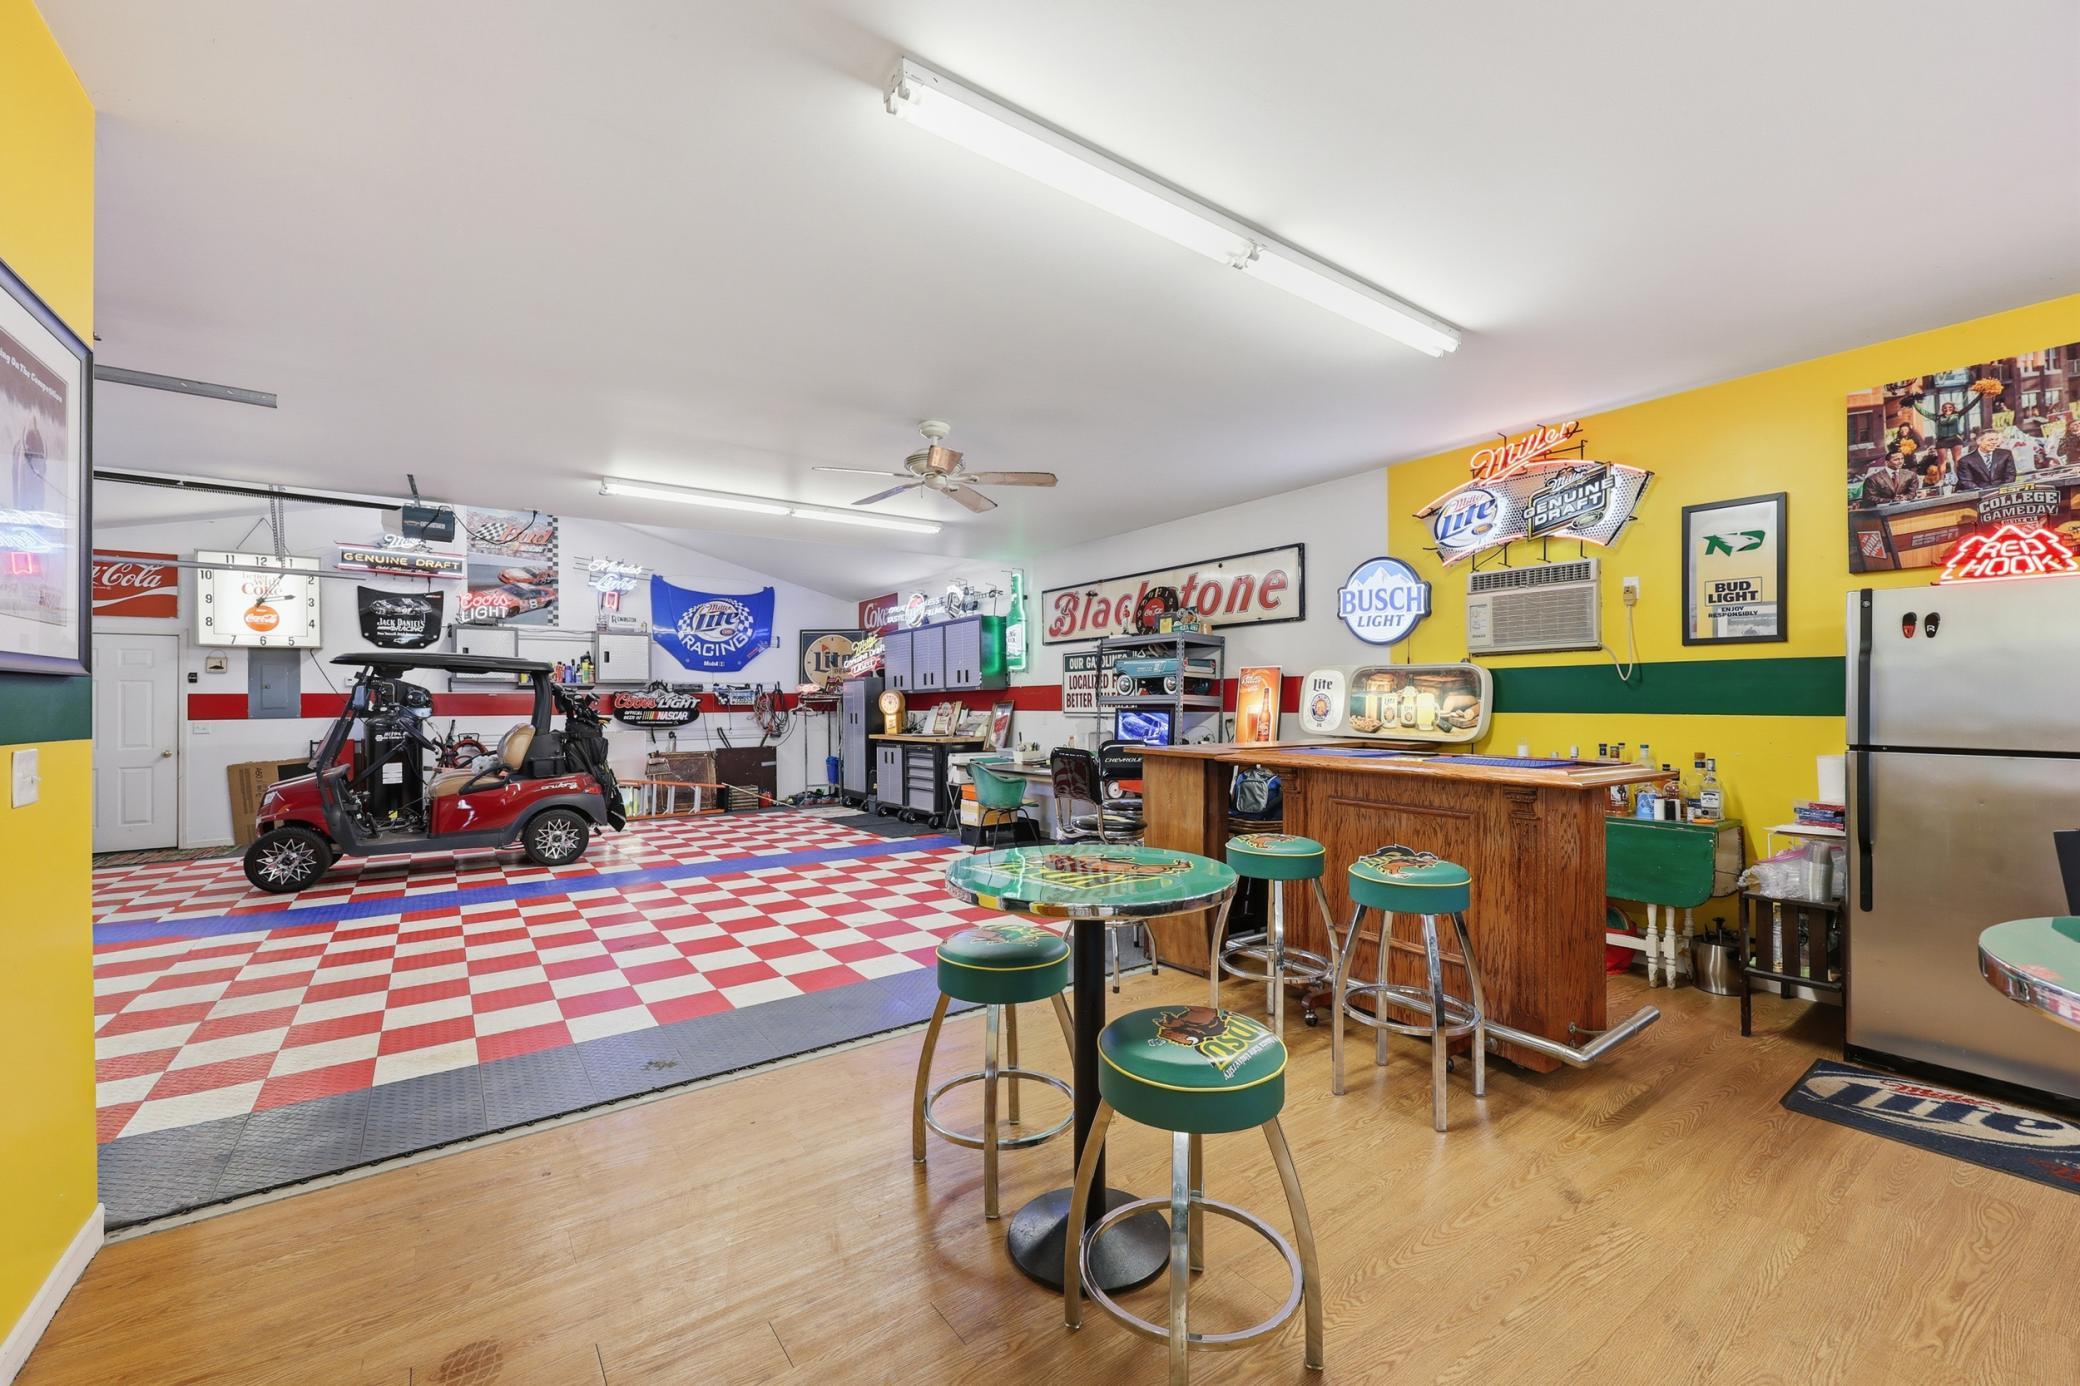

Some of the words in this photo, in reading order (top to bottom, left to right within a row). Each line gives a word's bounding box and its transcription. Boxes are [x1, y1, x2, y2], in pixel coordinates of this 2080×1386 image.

[1470, 421, 1578, 479] Miller
[1547, 470, 1588, 490] Miller
[1453, 494, 1484, 512] Miller
[1524, 477, 1614, 518] GENUINE
[1980, 492, 2057, 513] COLLEGE
[1535, 493, 1602, 525] DRAFT
[1983, 505, 2056, 522] GAMEDAY
[1440, 499, 1496, 540] Lite
[1976, 539, 2046, 557] RED
[256, 557, 267, 566] 12
[343, 552, 408, 566] GENUINE
[416, 559, 460, 570] DRAFT
[1959, 555, 2064, 576] HOOK
[200, 570, 212, 580] 10
[1715, 581, 1752, 593] BUD
[205, 594, 213, 604] 9
[308, 597, 315, 608] 3
[460, 592, 511, 608] Coors
[1048, 569, 1289, 637] Blactone
[1342, 586, 1422, 614] BUSCH
[1708, 591, 1759, 604] LIGHT
[205, 616, 213, 627] 8
[308, 618, 315, 628] 4
[377, 617, 395, 626] JACK
[461, 606, 509, 623] LIGHT
[694, 611, 740, 632] Lite
[1357, 614, 1405, 627] LIGHT
[1708, 610, 1758, 618] RESPONSIBLY
[231, 634, 237, 645] 7
[260, 636, 267, 645] 6
[288, 636, 295, 646] 5
[682, 633, 749, 657] RACING
[1069, 656, 1084, 669] OUR
[1086, 654, 1127, 668] GAOLI
[1069, 674, 1109, 689] LOCALID
[1313, 678, 1333, 692] Lite
[614, 692, 656, 708] Coors
[656, 698, 701, 709] LIGHT
[1066, 692, 1092, 708] BETTER
[657, 711, 688, 720] NASCAR
[1880, 1078, 2001, 1111] Miller
[1824, 1081, 2065, 1139] Lite
